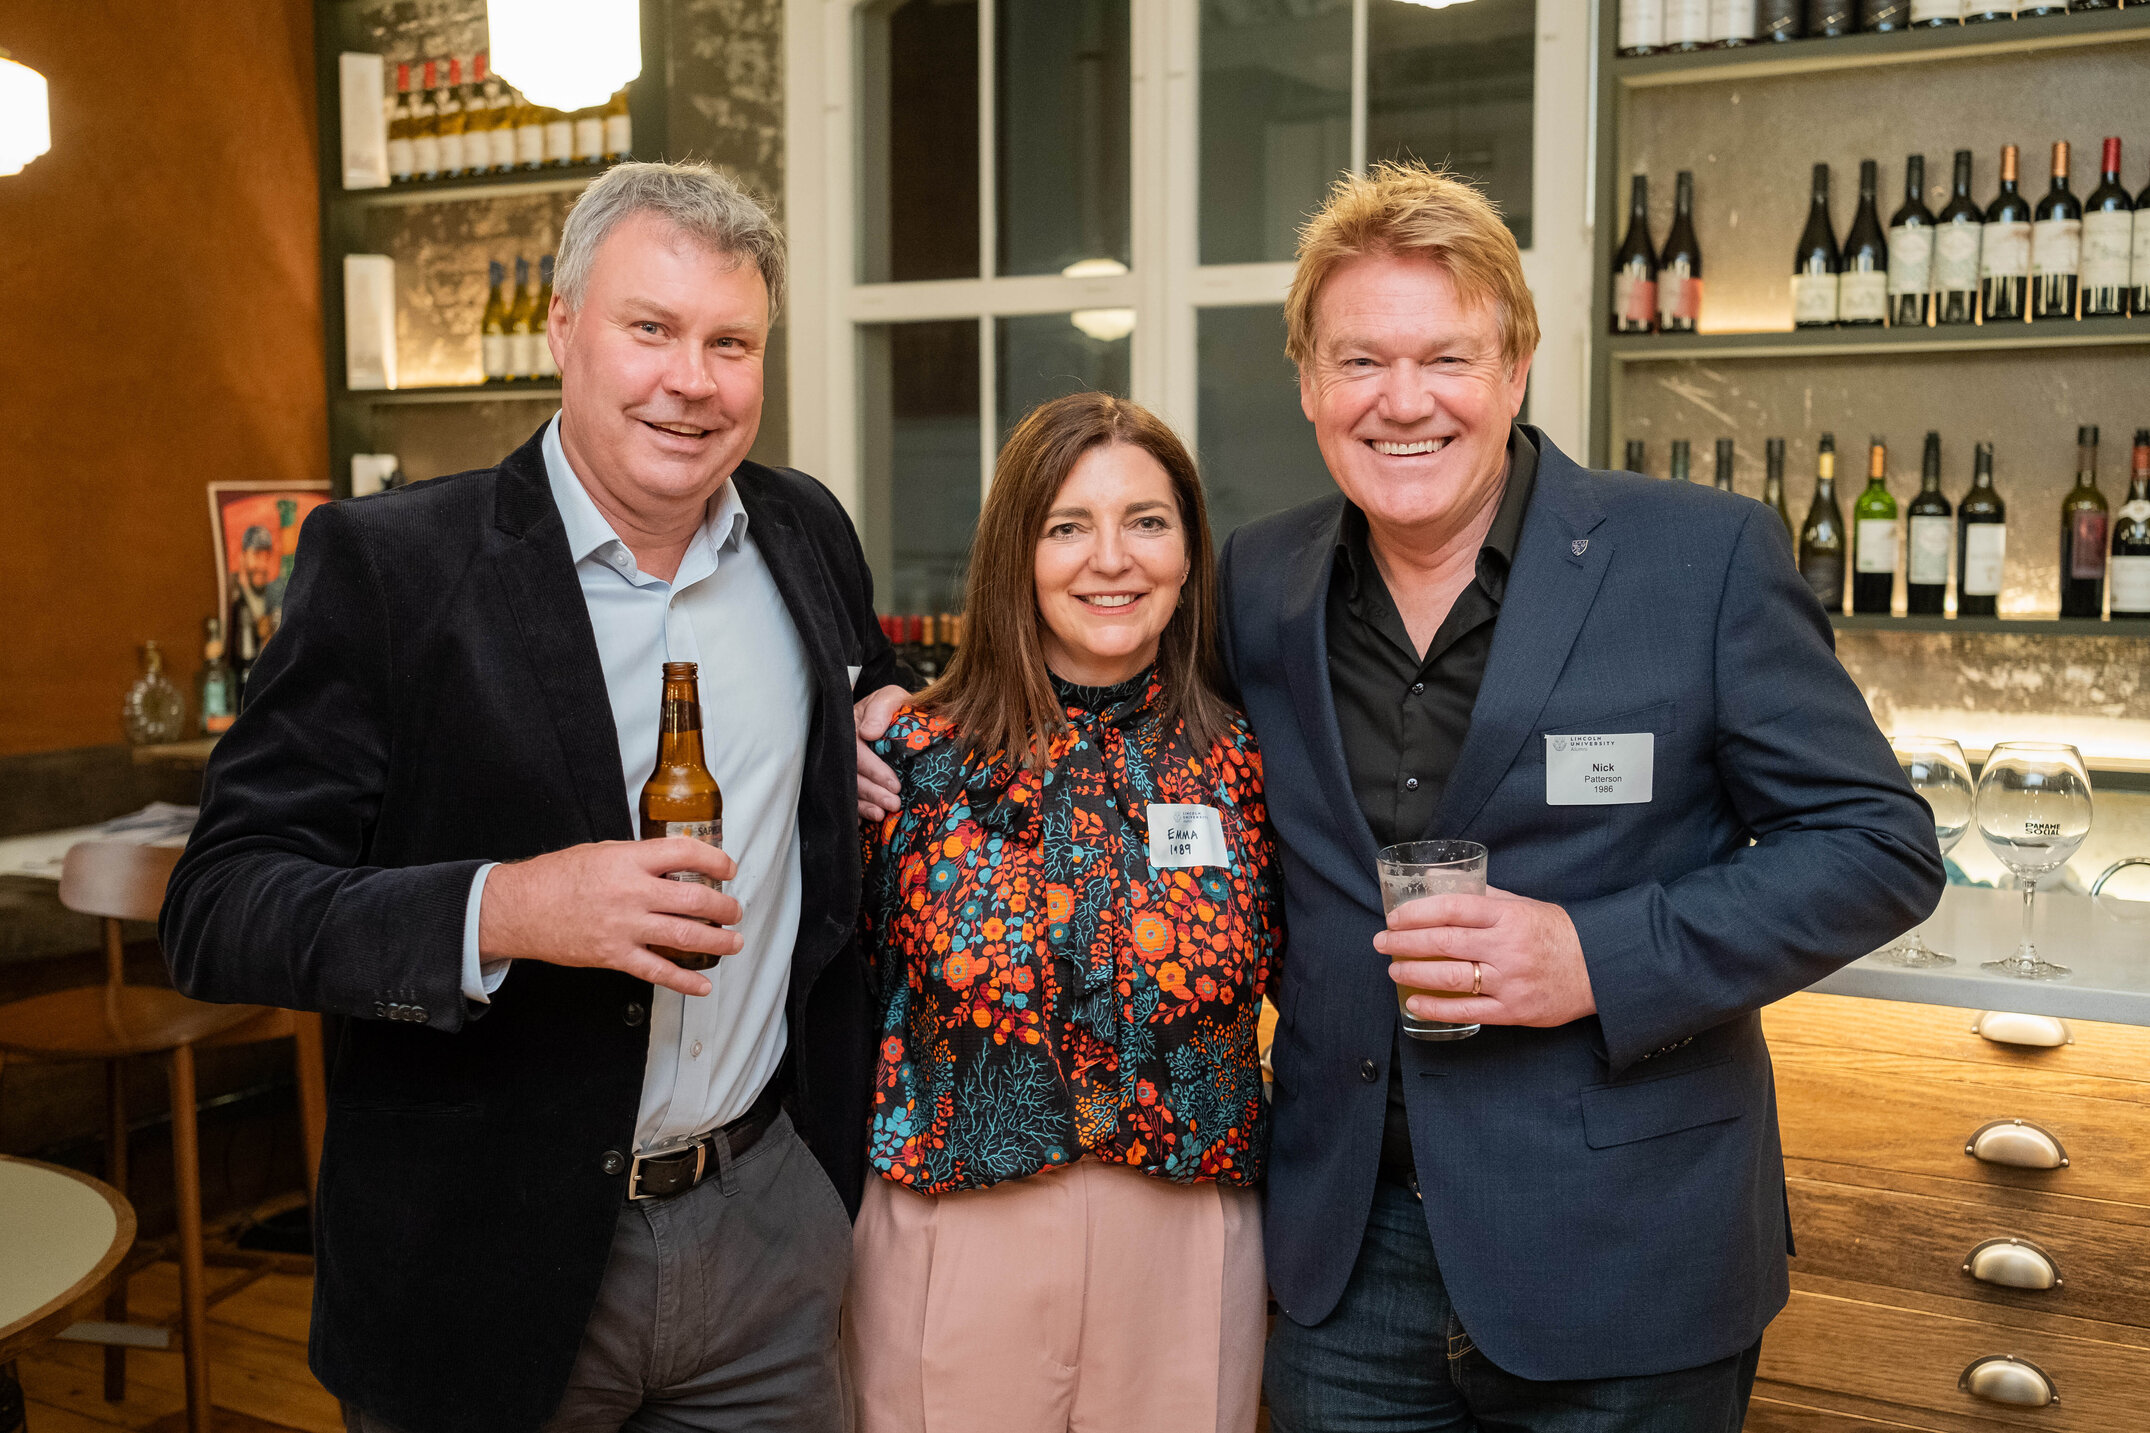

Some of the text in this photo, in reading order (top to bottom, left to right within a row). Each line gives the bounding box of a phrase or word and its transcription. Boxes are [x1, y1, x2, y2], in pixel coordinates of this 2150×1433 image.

[1592, 763, 1615, 772] Nick
[1584, 775, 1623, 783] Patterson
[1594, 785, 1614, 793] 1986
[2025, 822, 2061, 830] PANAME
[1167, 827, 1199, 840] EMMA
[1170, 843, 1192, 855] 1989
